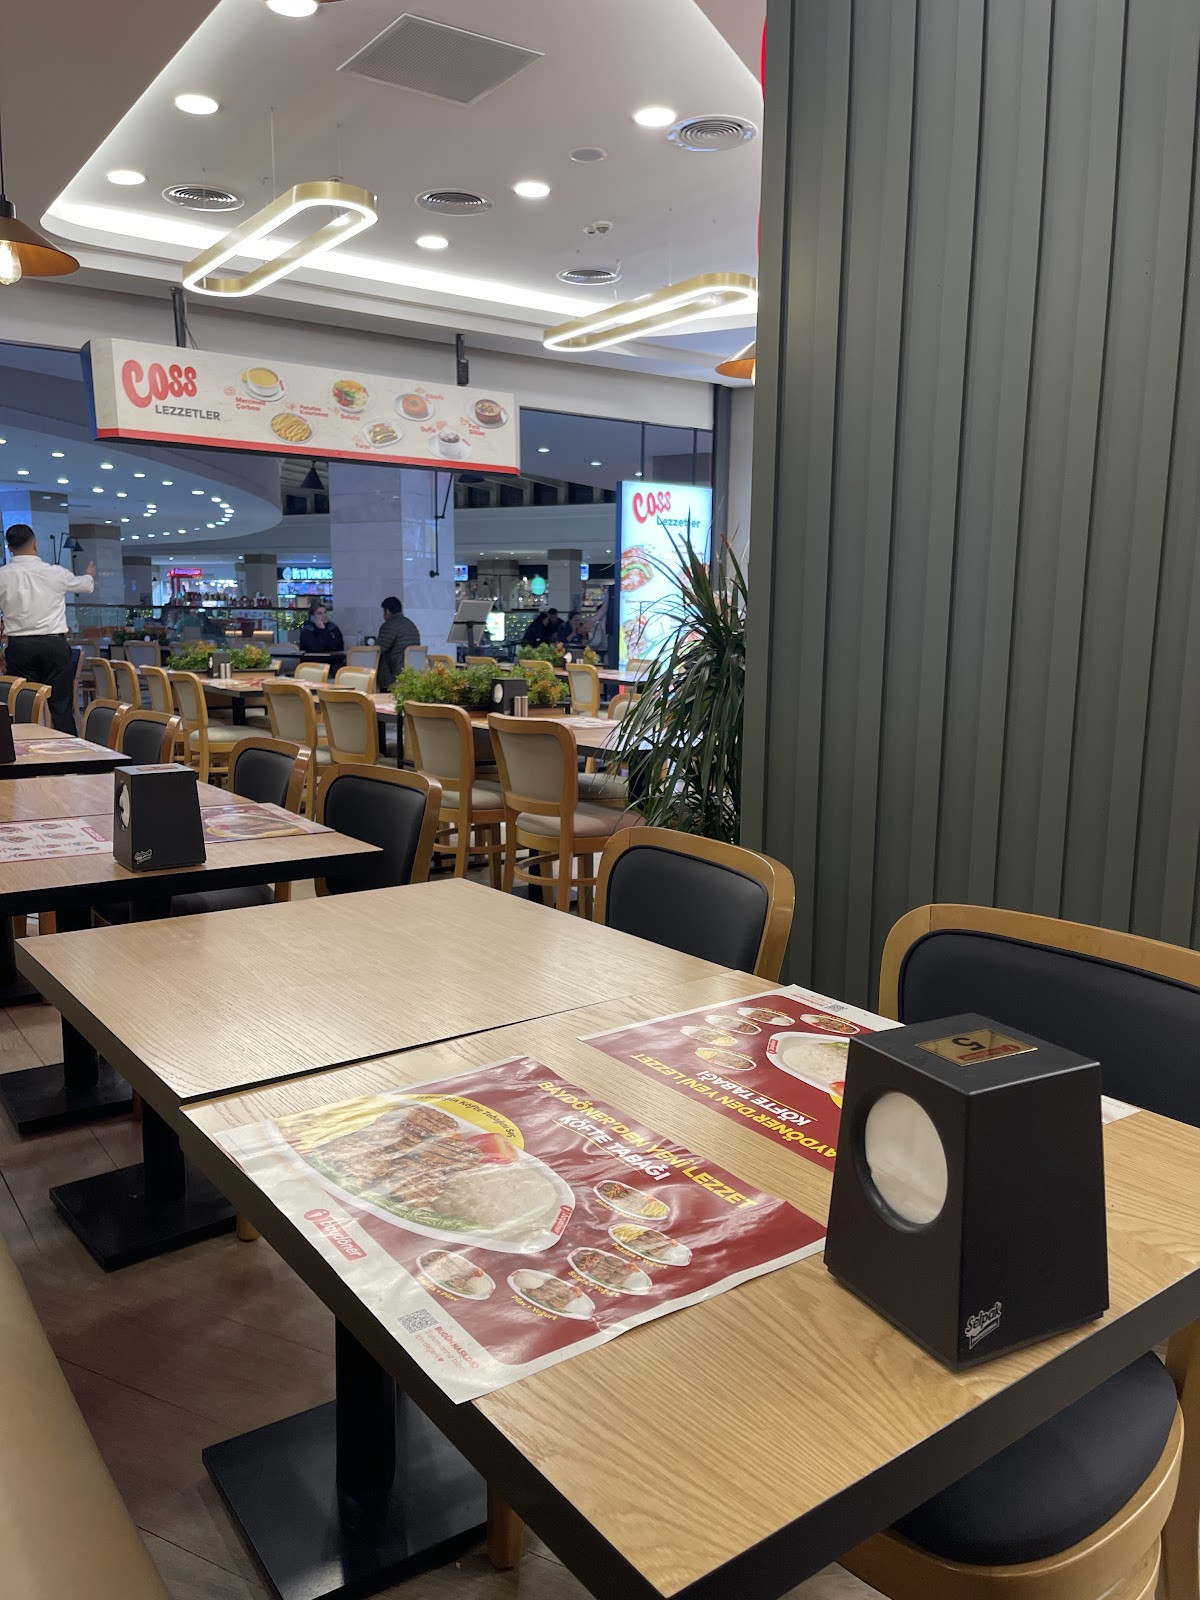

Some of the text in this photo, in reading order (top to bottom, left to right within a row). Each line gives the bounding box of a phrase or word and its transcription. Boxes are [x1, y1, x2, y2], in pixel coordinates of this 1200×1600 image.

[155, 404, 221, 421] LEZZETLER
[656, 516, 701, 529] Lezzeter
[951, 1037, 986, 1051] 5
[630, 1052, 685, 1081] LEZZET
[675, 1075, 716, 1097] YENİ
[695, 1070, 812, 1127] KÖFTE TABAĞI
[716, 1094, 837, 1159] AYDÖNER'DEN
[537, 1080, 760, 1210] BAYDÖNER'DEN YENİ LEZZET
[557, 1113, 672, 1182] KÖFTE TABAĞI
[965, 1301, 1002, 1337] Selpak
